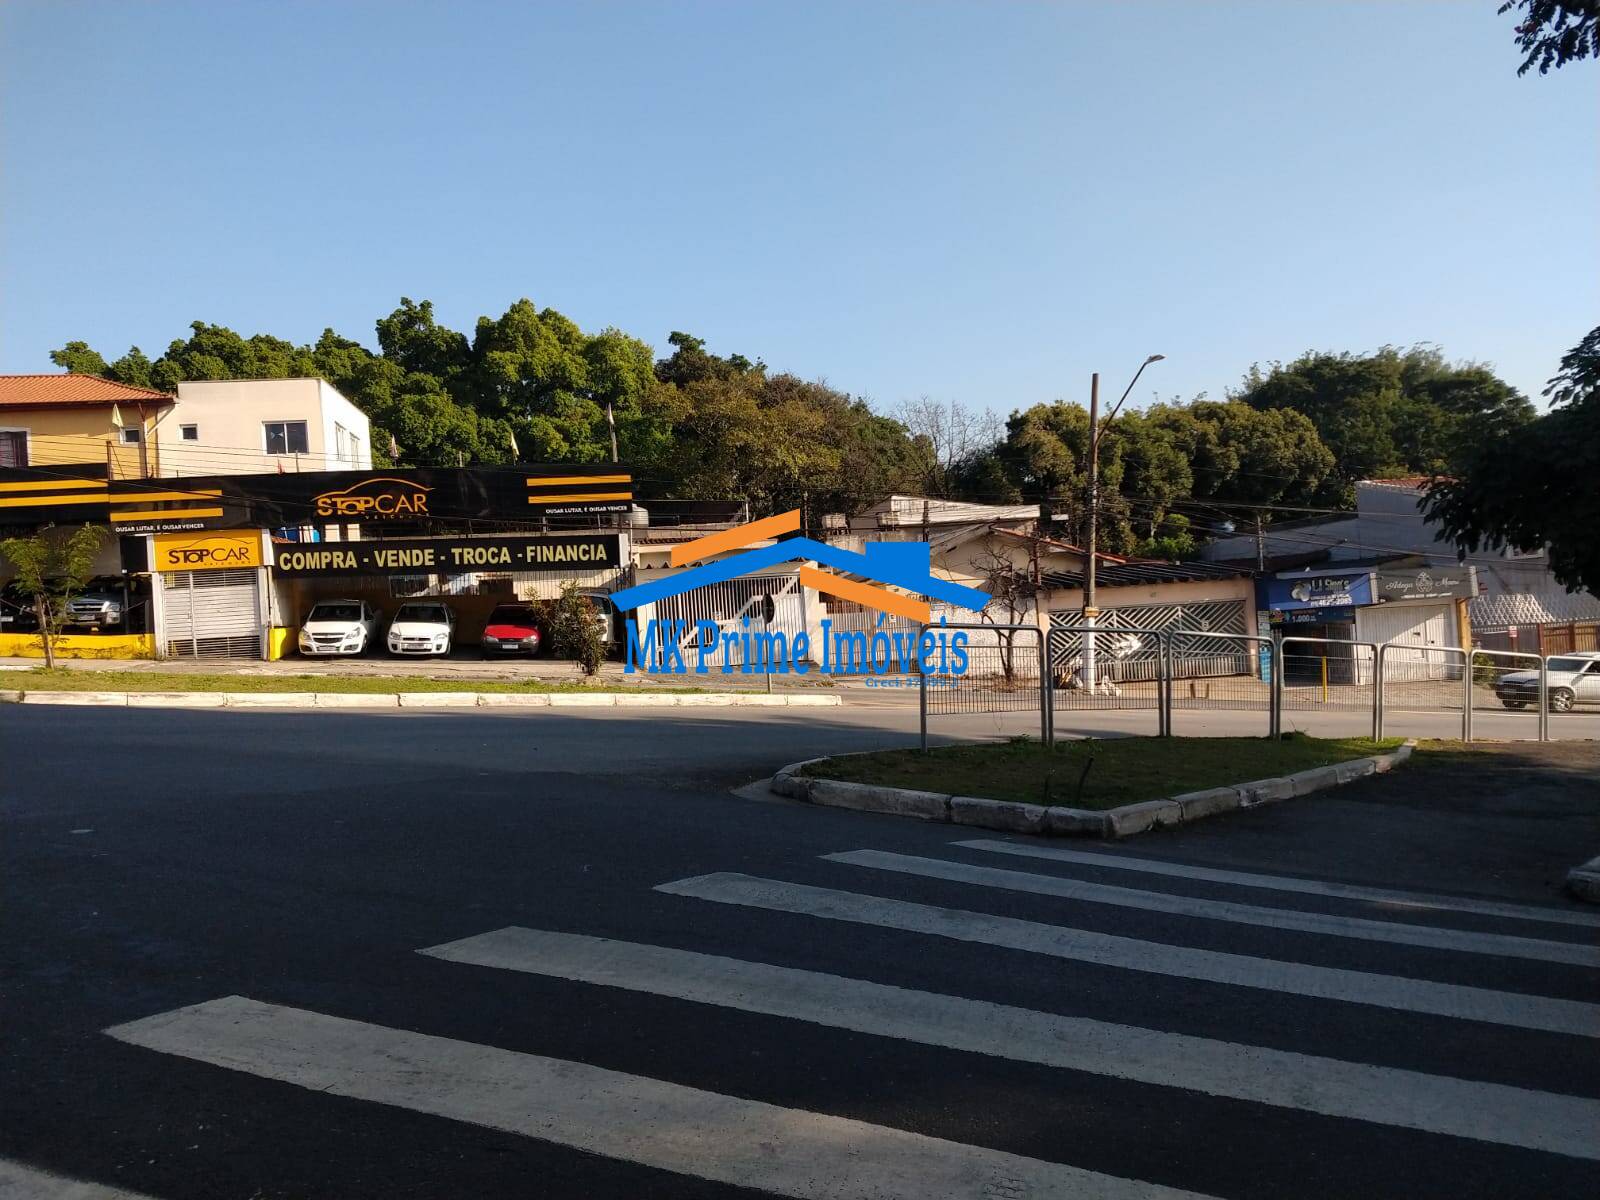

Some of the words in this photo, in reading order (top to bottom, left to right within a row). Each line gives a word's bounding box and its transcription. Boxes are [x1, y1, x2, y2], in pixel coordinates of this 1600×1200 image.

[317, 493, 429, 516] STOPCAR
[168, 547, 250, 564] STOPCAR
[279, 549, 358, 571] COMPRA
[374, 548, 435, 568] VENDE
[451, 546, 512, 566] TROCA
[526, 543, 608, 563] FINANCIA
